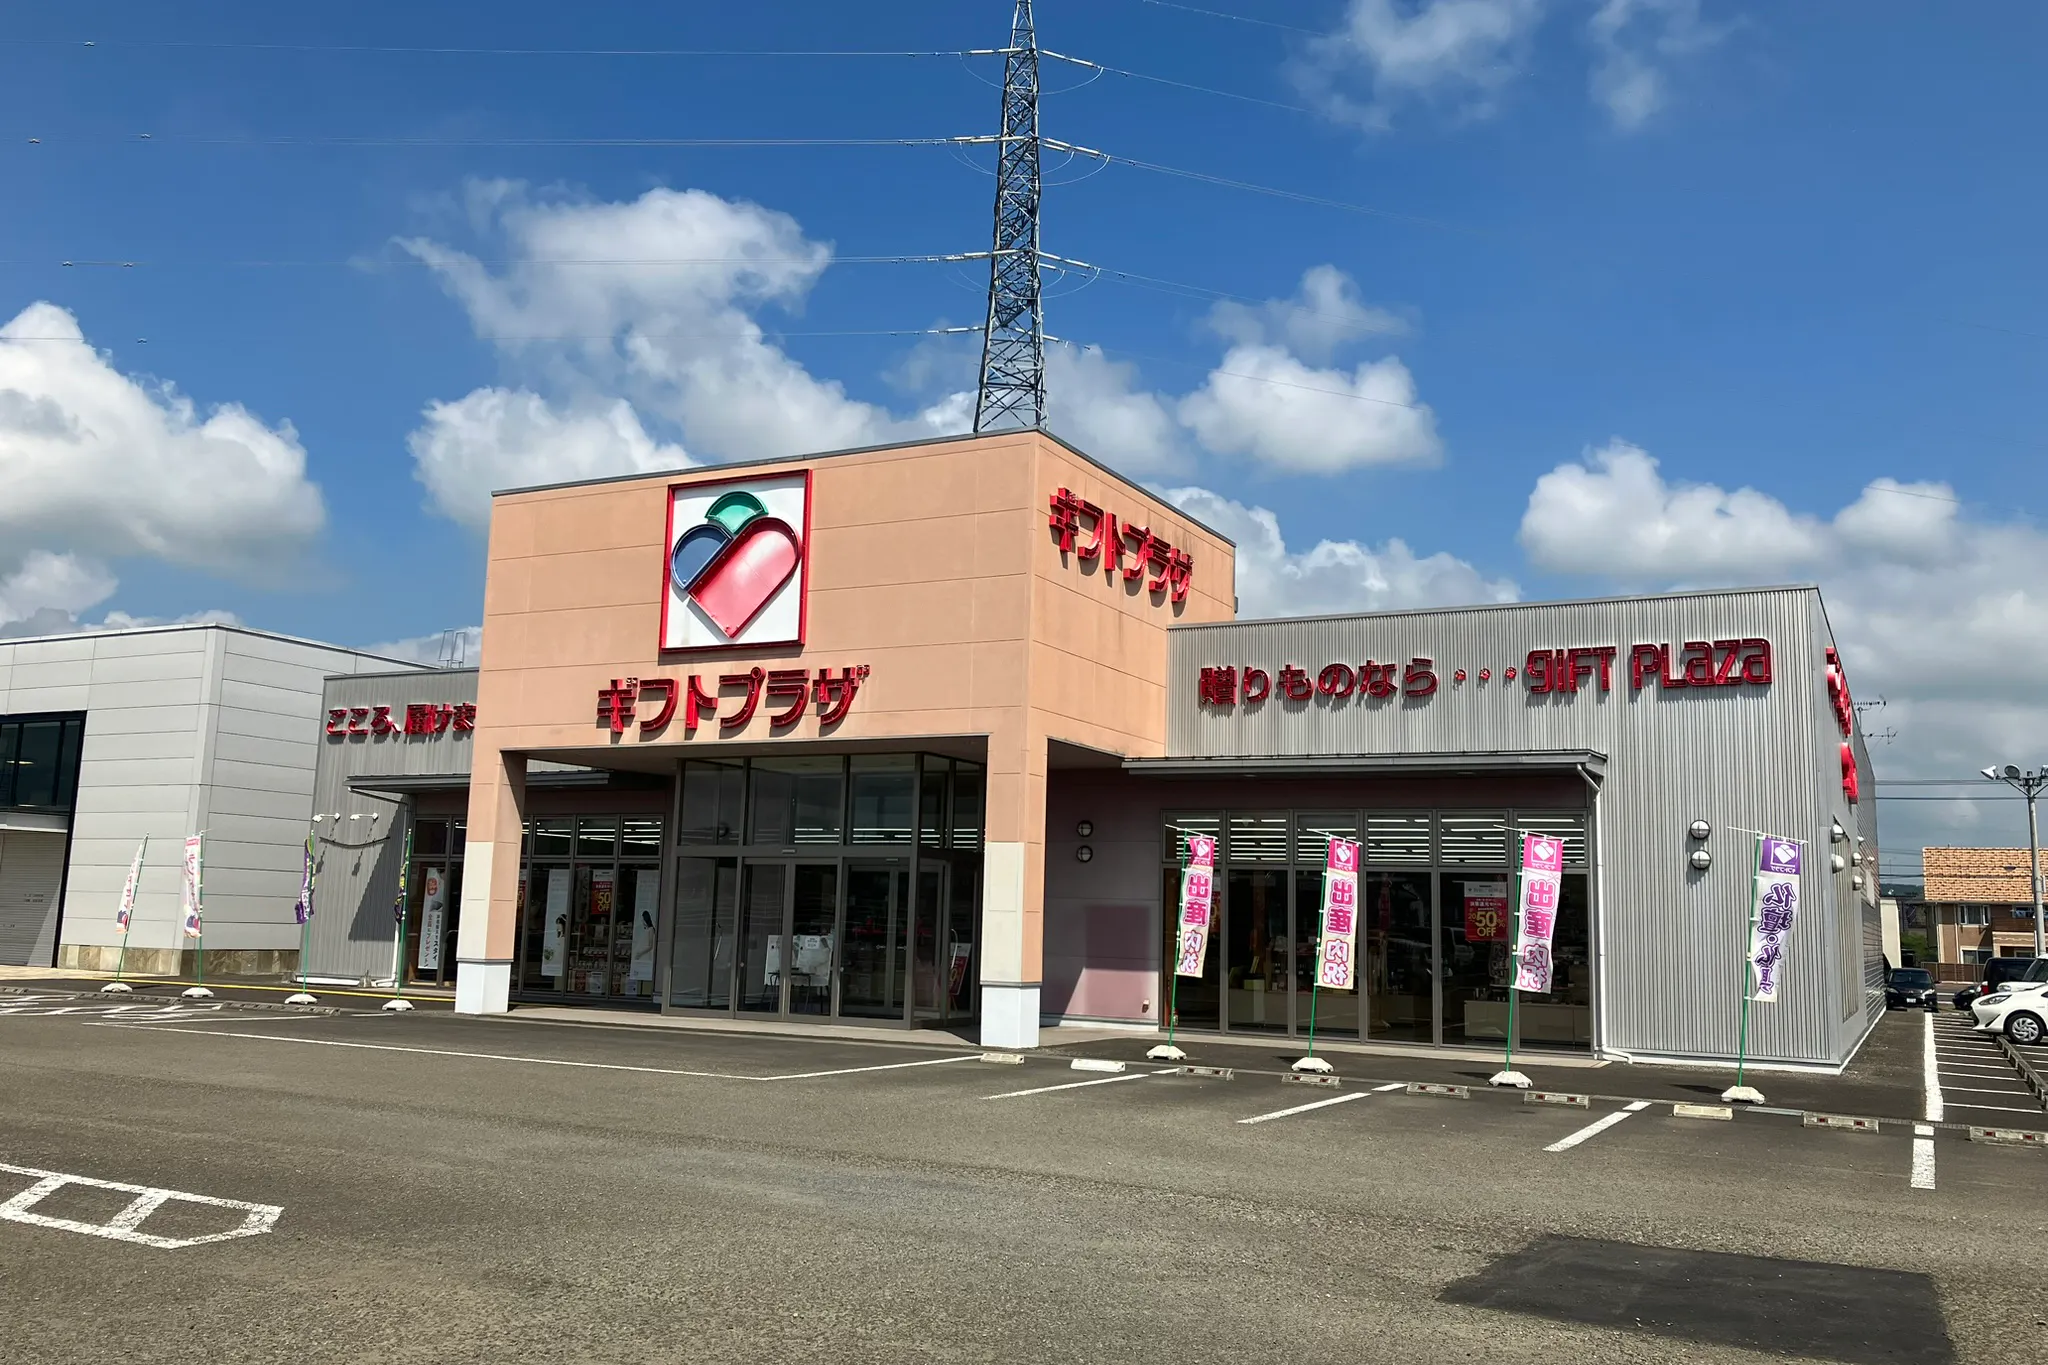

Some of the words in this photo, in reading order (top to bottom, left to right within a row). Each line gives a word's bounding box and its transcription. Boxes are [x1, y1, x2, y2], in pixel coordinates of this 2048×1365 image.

[1049, 486, 1195, 602] ギフトプラザ
[597, 665, 870, 733] ギフトプラザ
[1475, 911, 1497, 927] 50
[1477, 927, 1497, 937] OFF
